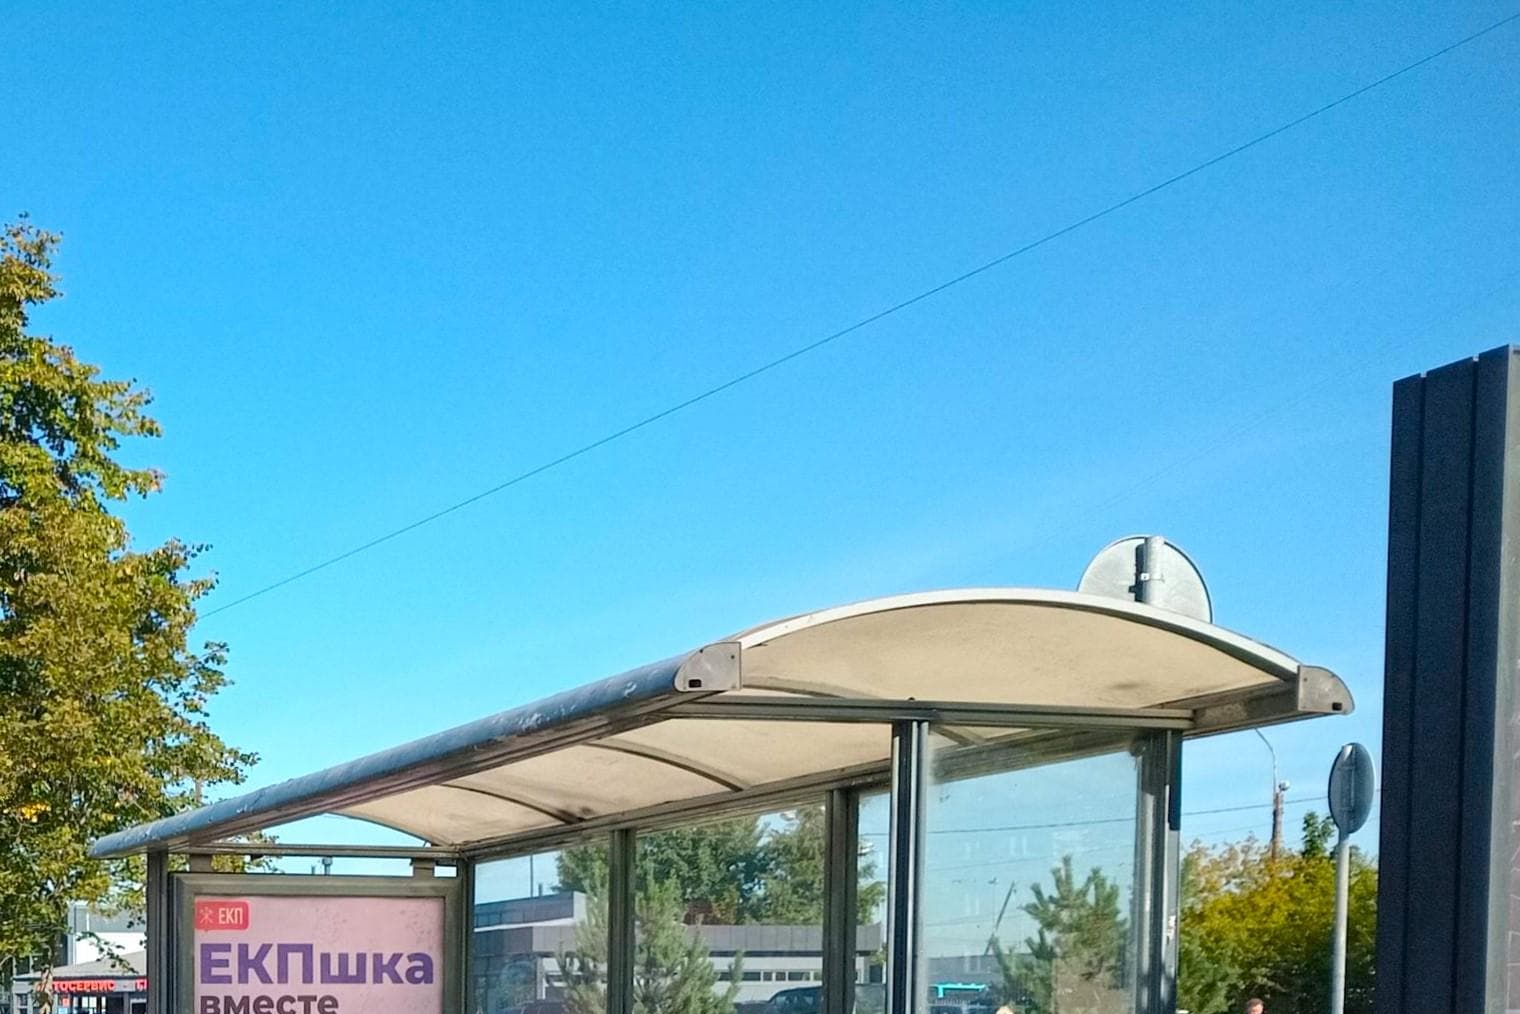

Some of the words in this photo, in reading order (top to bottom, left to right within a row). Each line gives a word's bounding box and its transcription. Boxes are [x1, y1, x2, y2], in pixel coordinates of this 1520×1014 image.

[218, 908, 244, 925] ЕКП
[200, 943, 434, 985] ЕКПшка
[36, 979, 116, 992] ТОСЕРВИС
